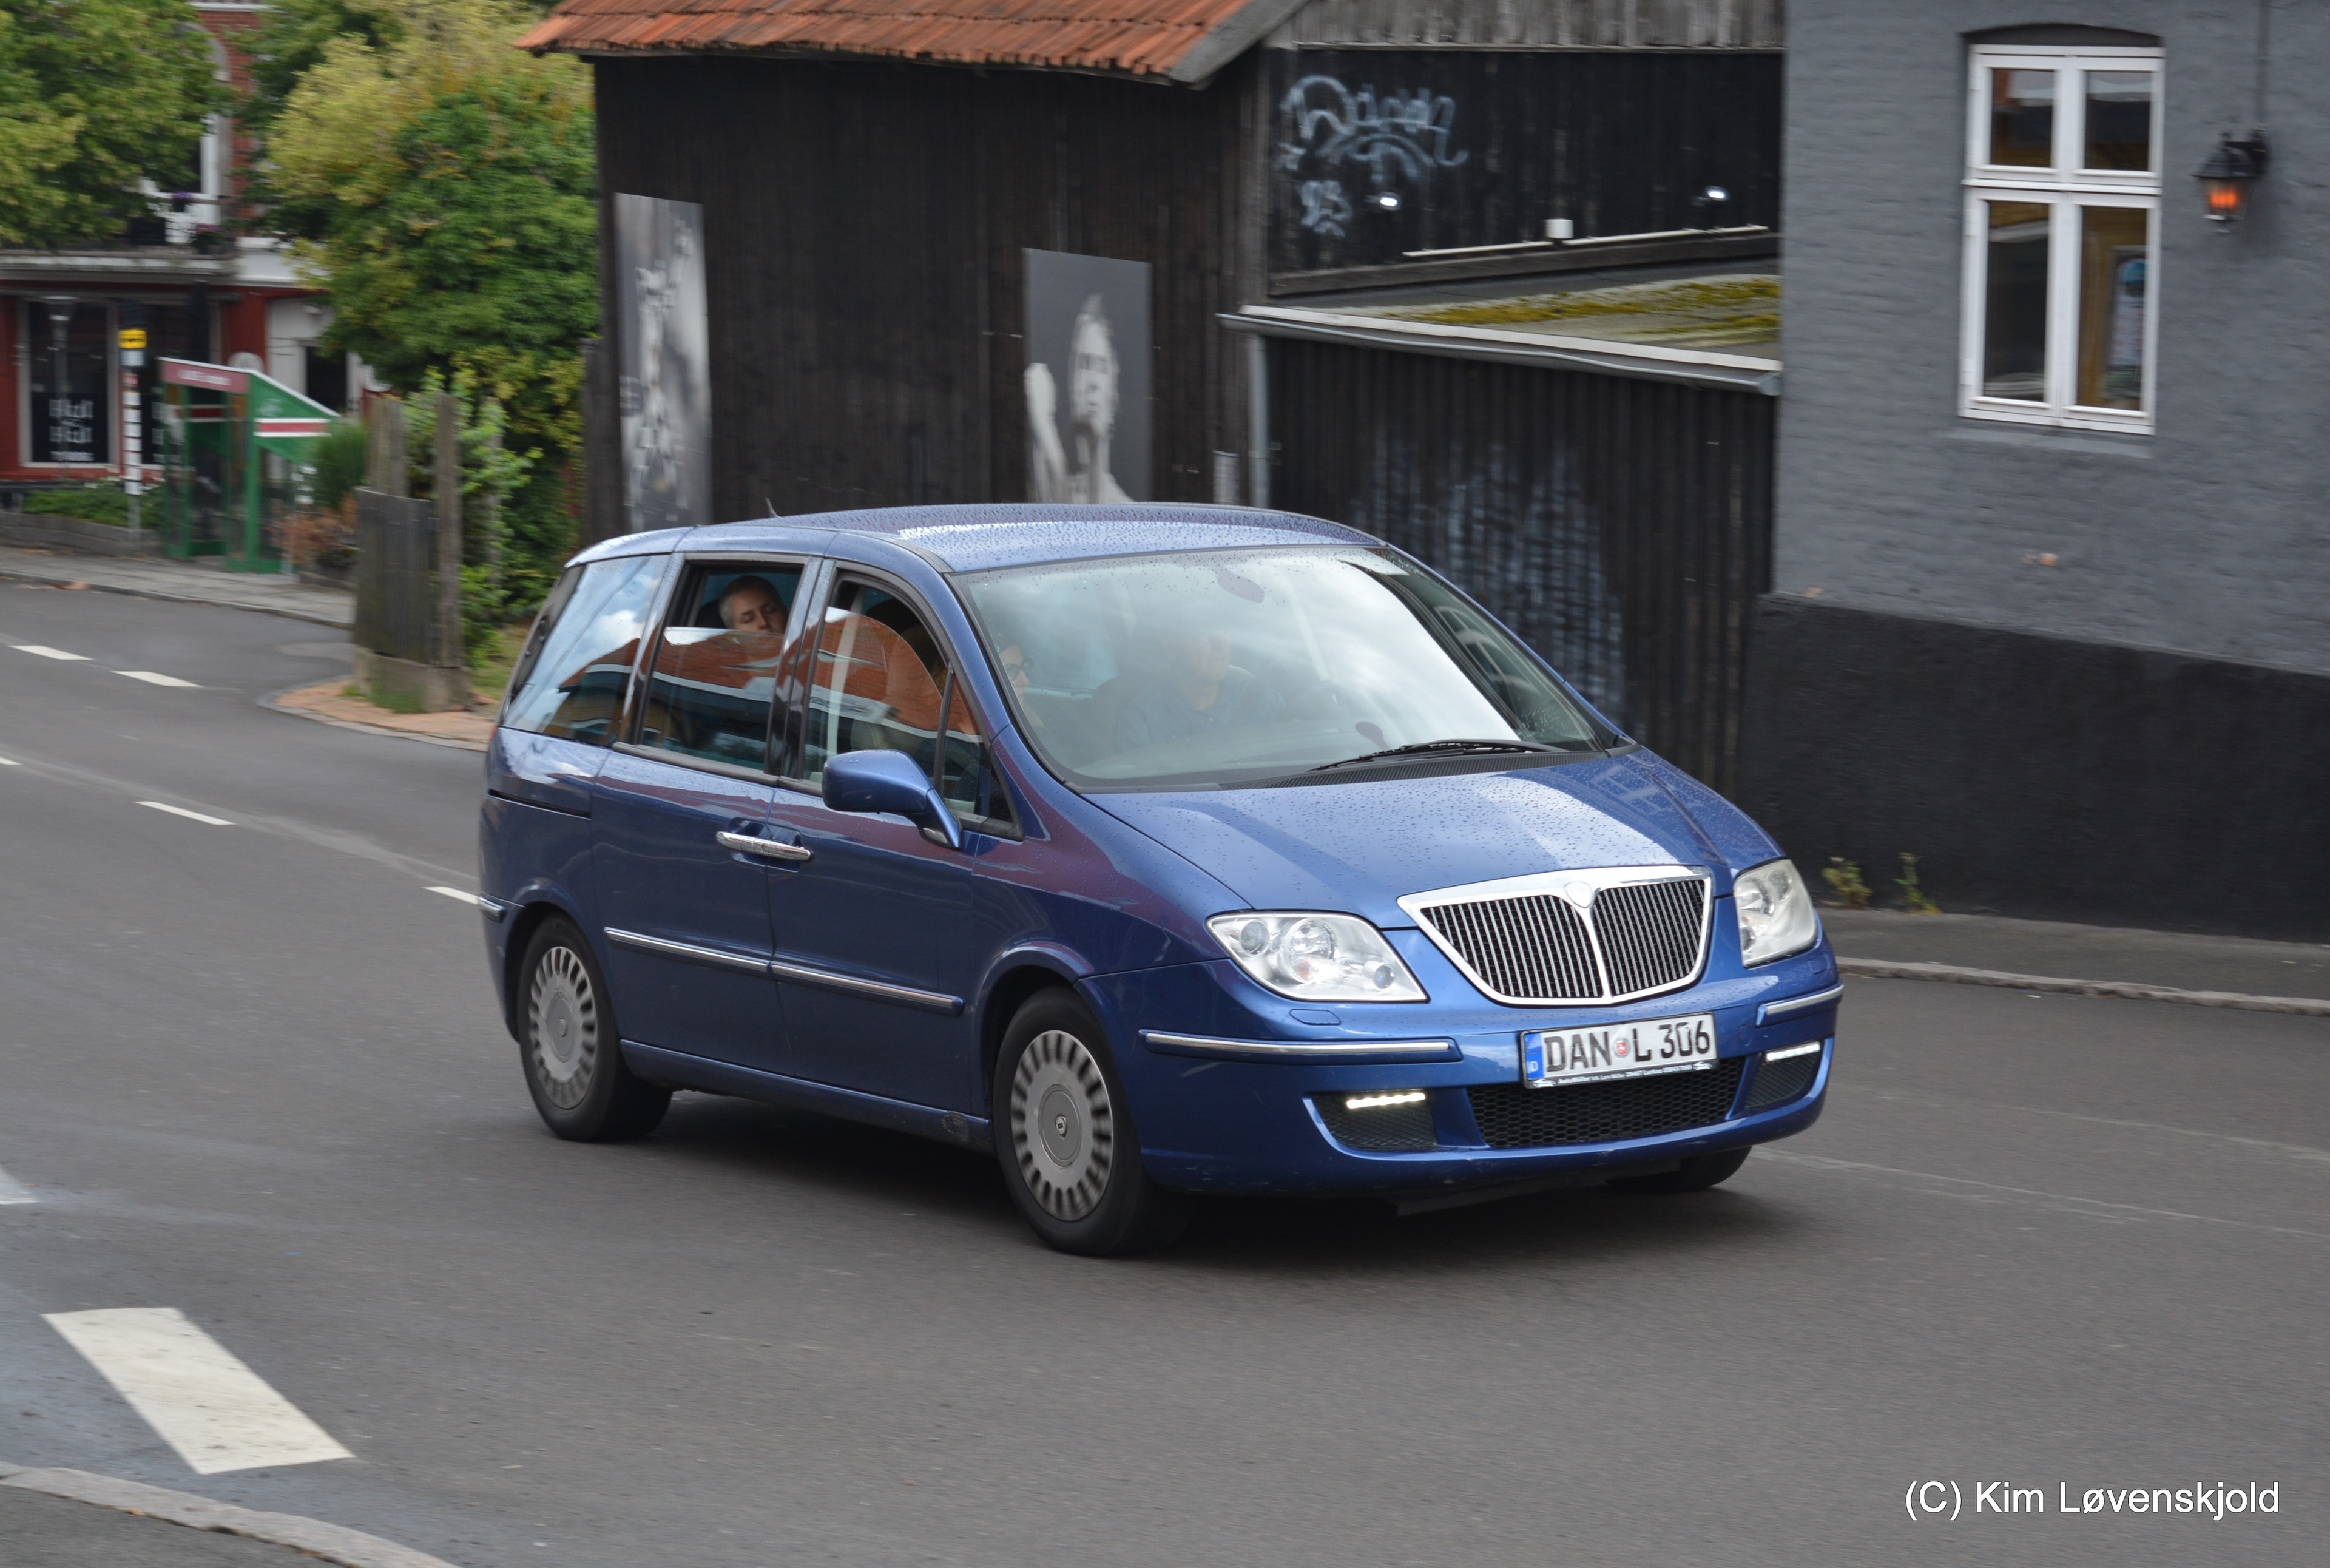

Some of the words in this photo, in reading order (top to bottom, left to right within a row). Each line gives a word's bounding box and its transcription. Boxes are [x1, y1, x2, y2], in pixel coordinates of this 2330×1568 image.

[1544, 1031, 1611, 1072] DAN
[1633, 1027, 1652, 1063] L
[1658, 1020, 1711, 1059] 306
